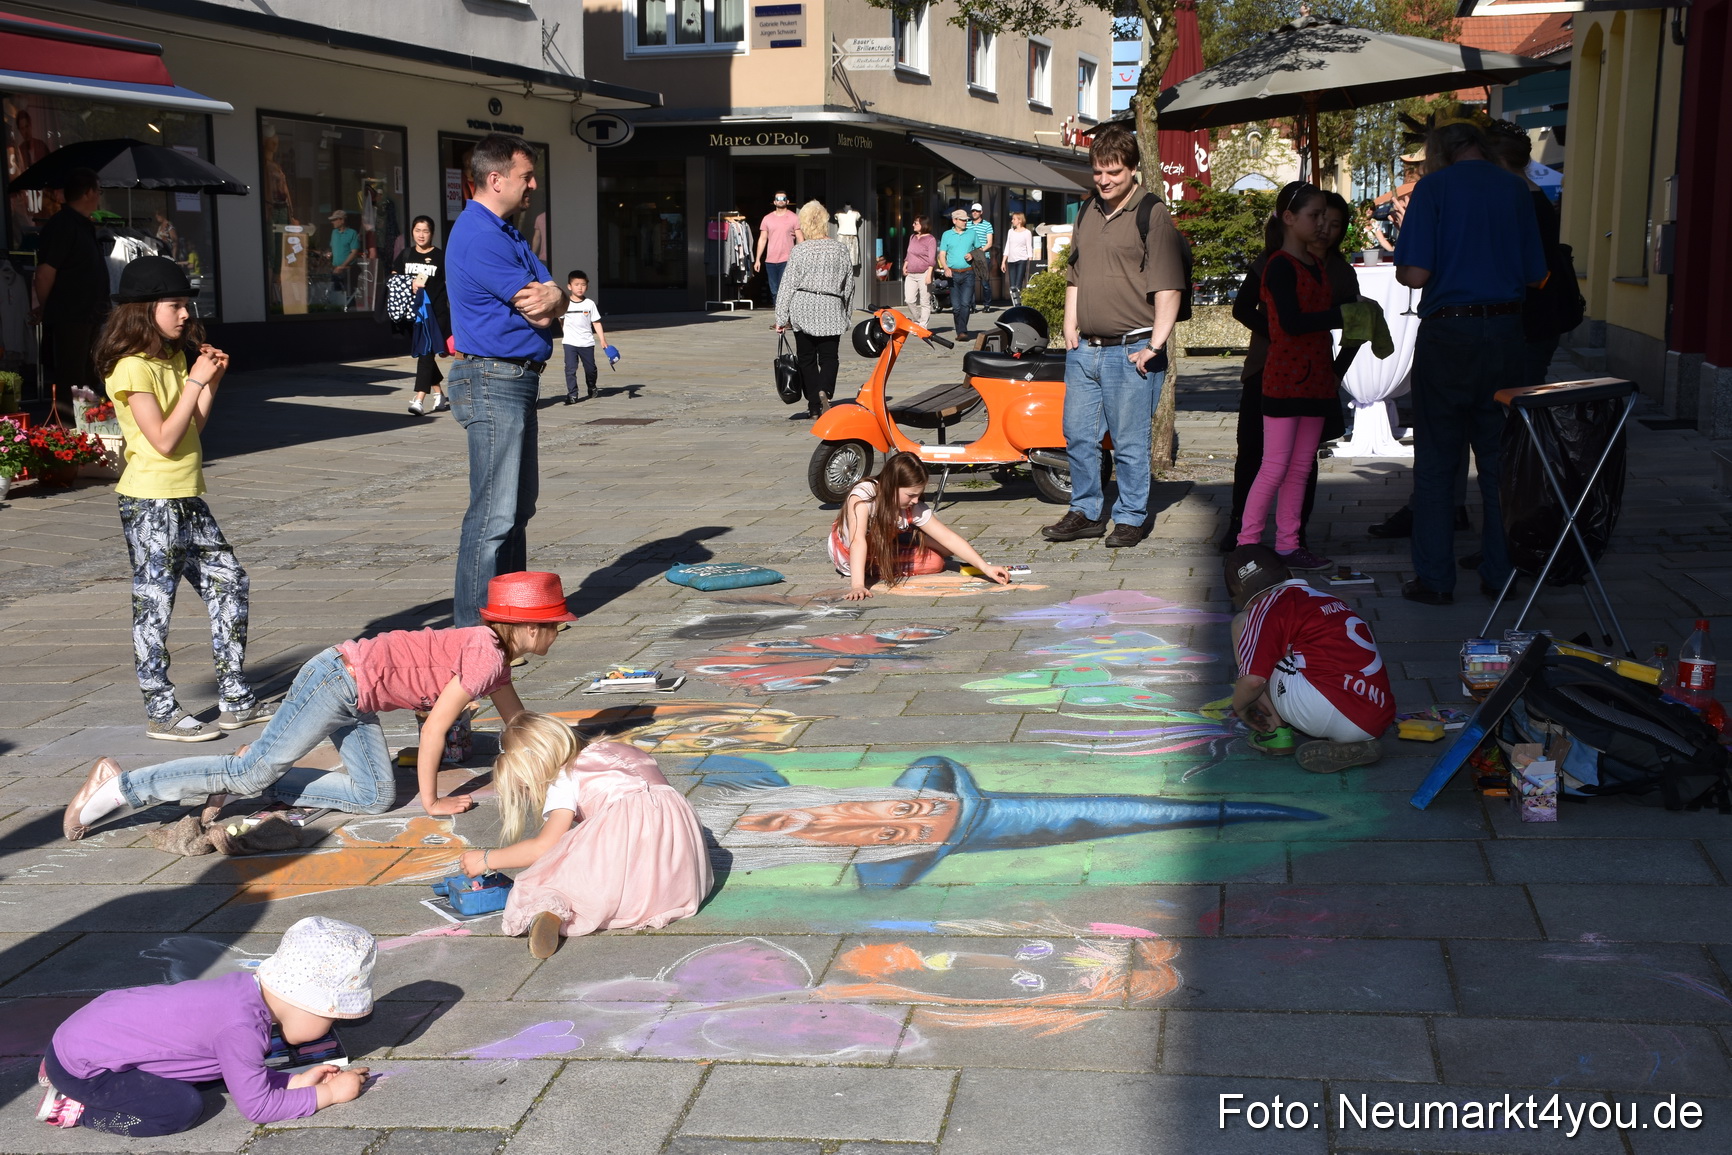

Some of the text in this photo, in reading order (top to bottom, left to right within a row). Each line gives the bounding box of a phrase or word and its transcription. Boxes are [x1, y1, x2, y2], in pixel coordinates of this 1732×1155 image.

[760, 29, 776, 37] Jürgen
[709, 133, 809, 146] Marc O'Polo
[837, 133, 873, 149] Marc O'Polo
[1345, 616, 1383, 677] 9
[1343, 673, 1386, 709] TONI
